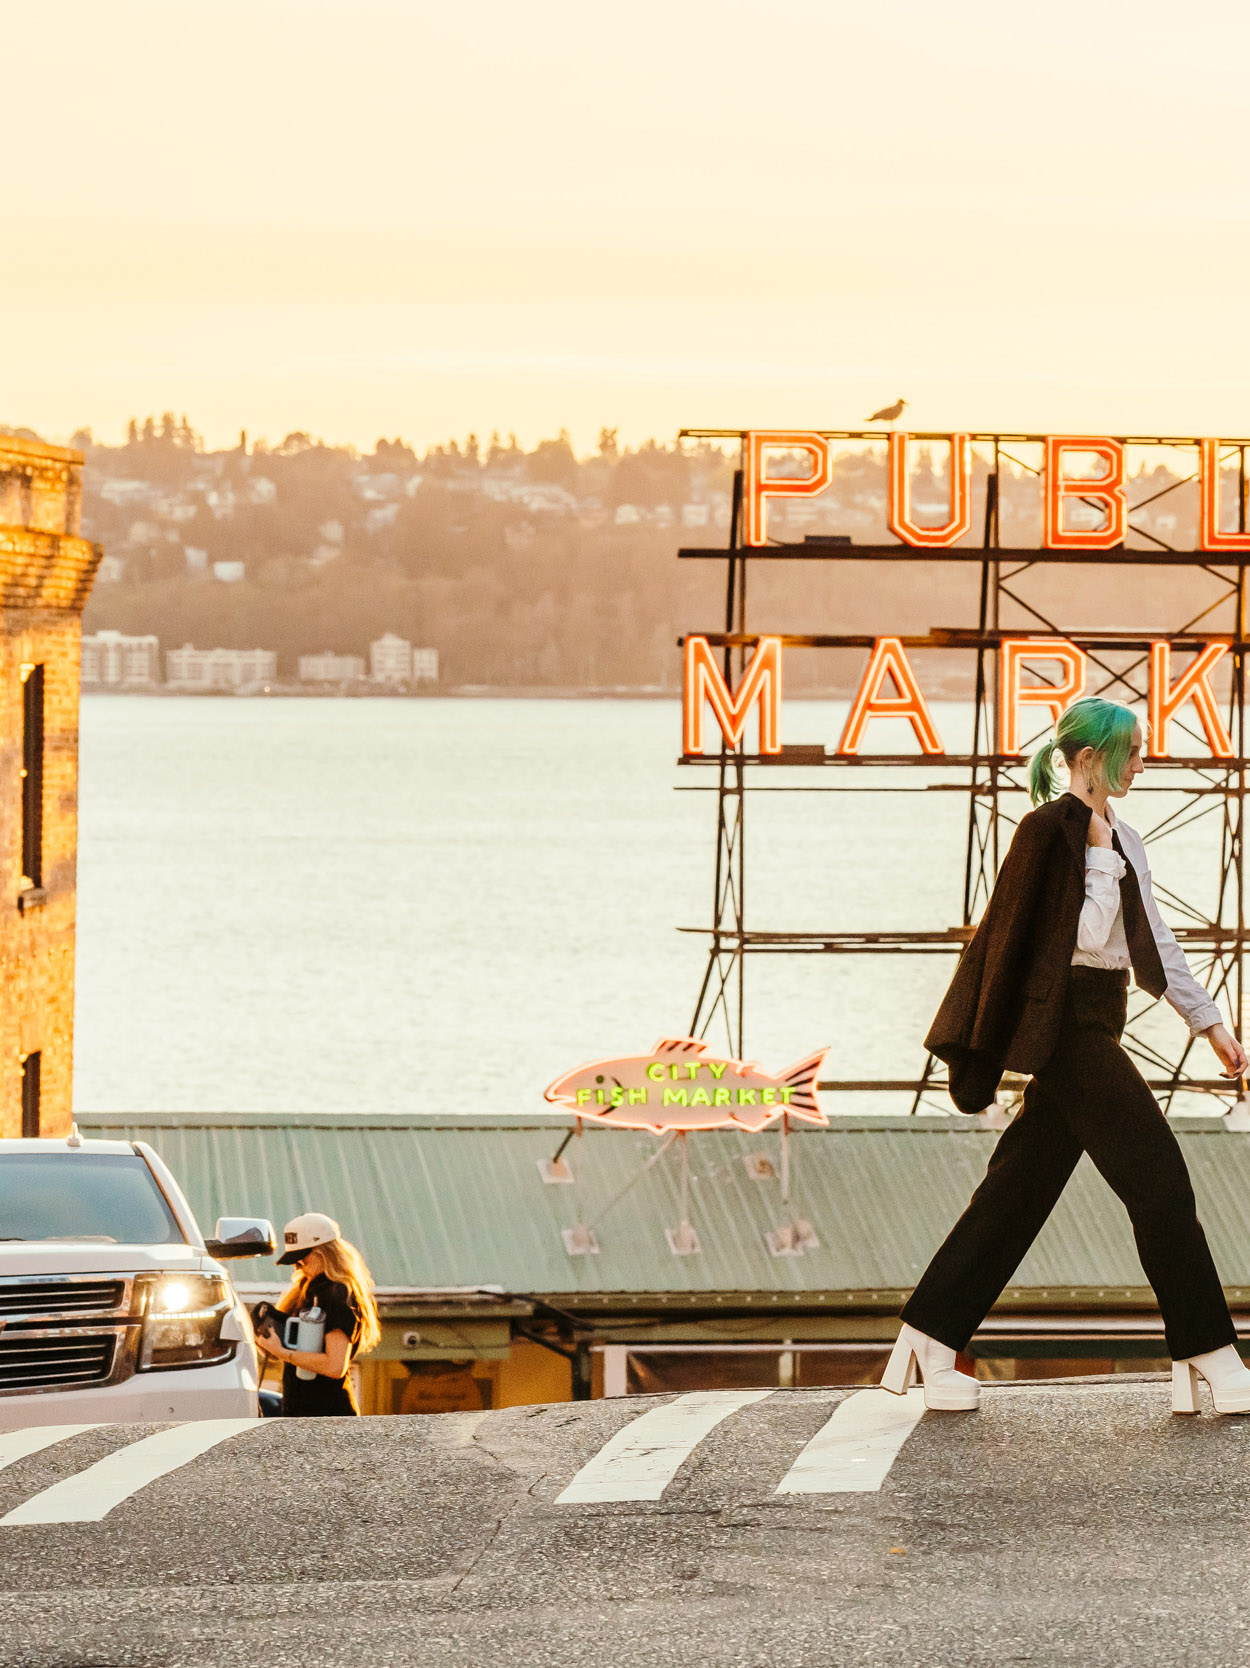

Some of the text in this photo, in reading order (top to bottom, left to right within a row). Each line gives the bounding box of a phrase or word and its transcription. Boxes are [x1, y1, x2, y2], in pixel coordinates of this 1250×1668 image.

[647, 1062, 728, 1082] CITY
[577, 1087, 796, 1107] FISH MARKET
